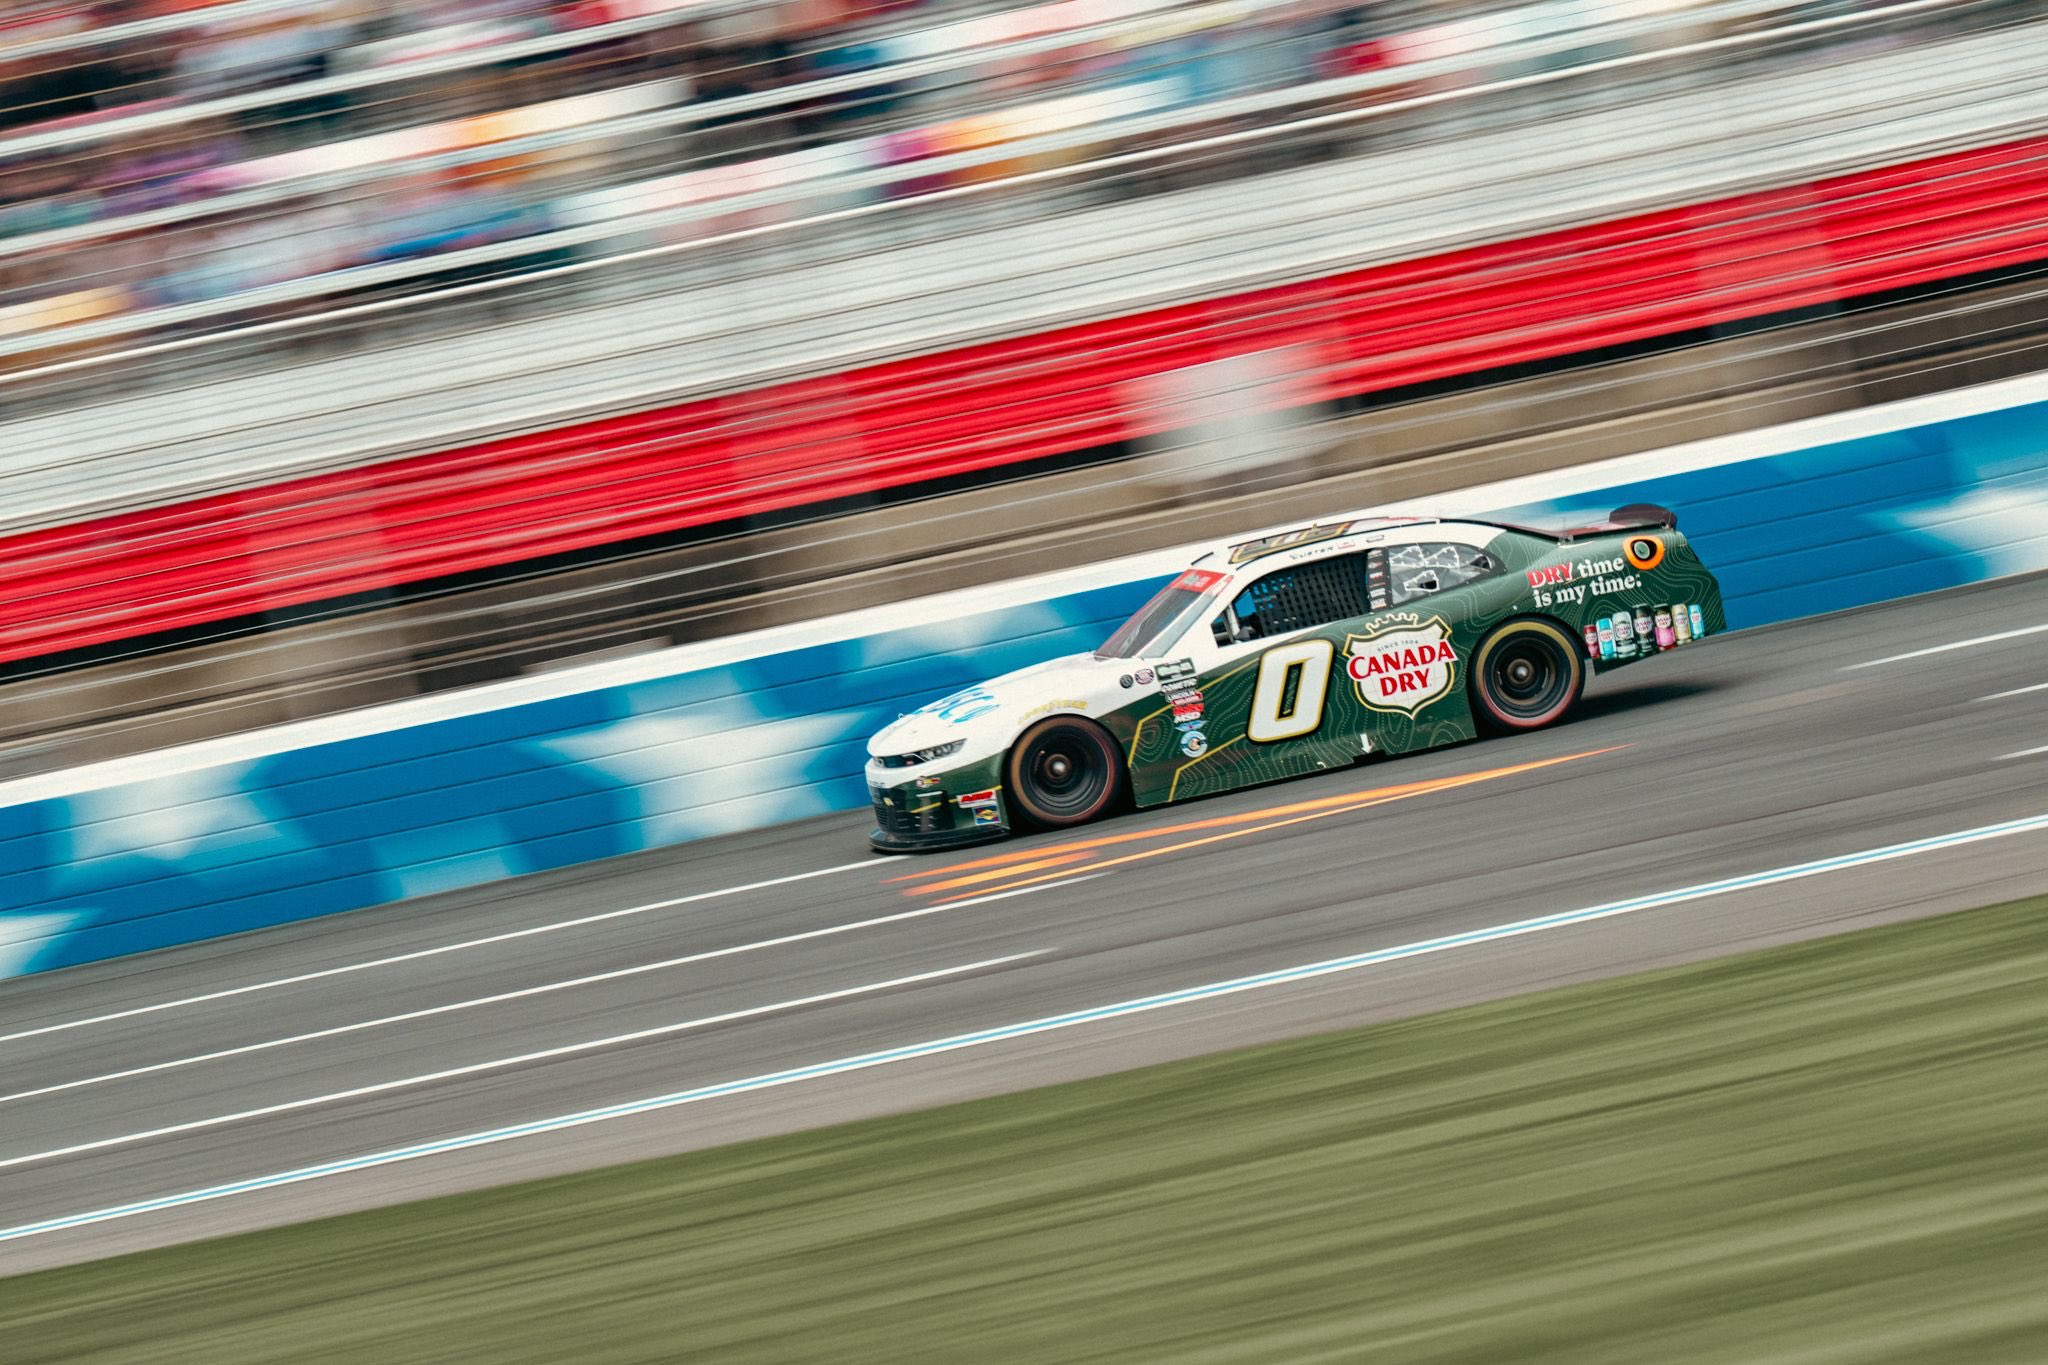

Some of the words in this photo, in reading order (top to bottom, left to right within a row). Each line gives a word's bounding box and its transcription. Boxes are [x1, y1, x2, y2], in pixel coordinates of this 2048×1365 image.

[1526, 562, 1572, 588] DRY
[1577, 557, 1625, 578] time
[1532, 589, 1553, 608] is
[1556, 585, 1586, 604] my
[1349, 641, 1455, 680] CANADA
[1248, 639, 1334, 743] 0
[1379, 668, 1429, 697] DRY
